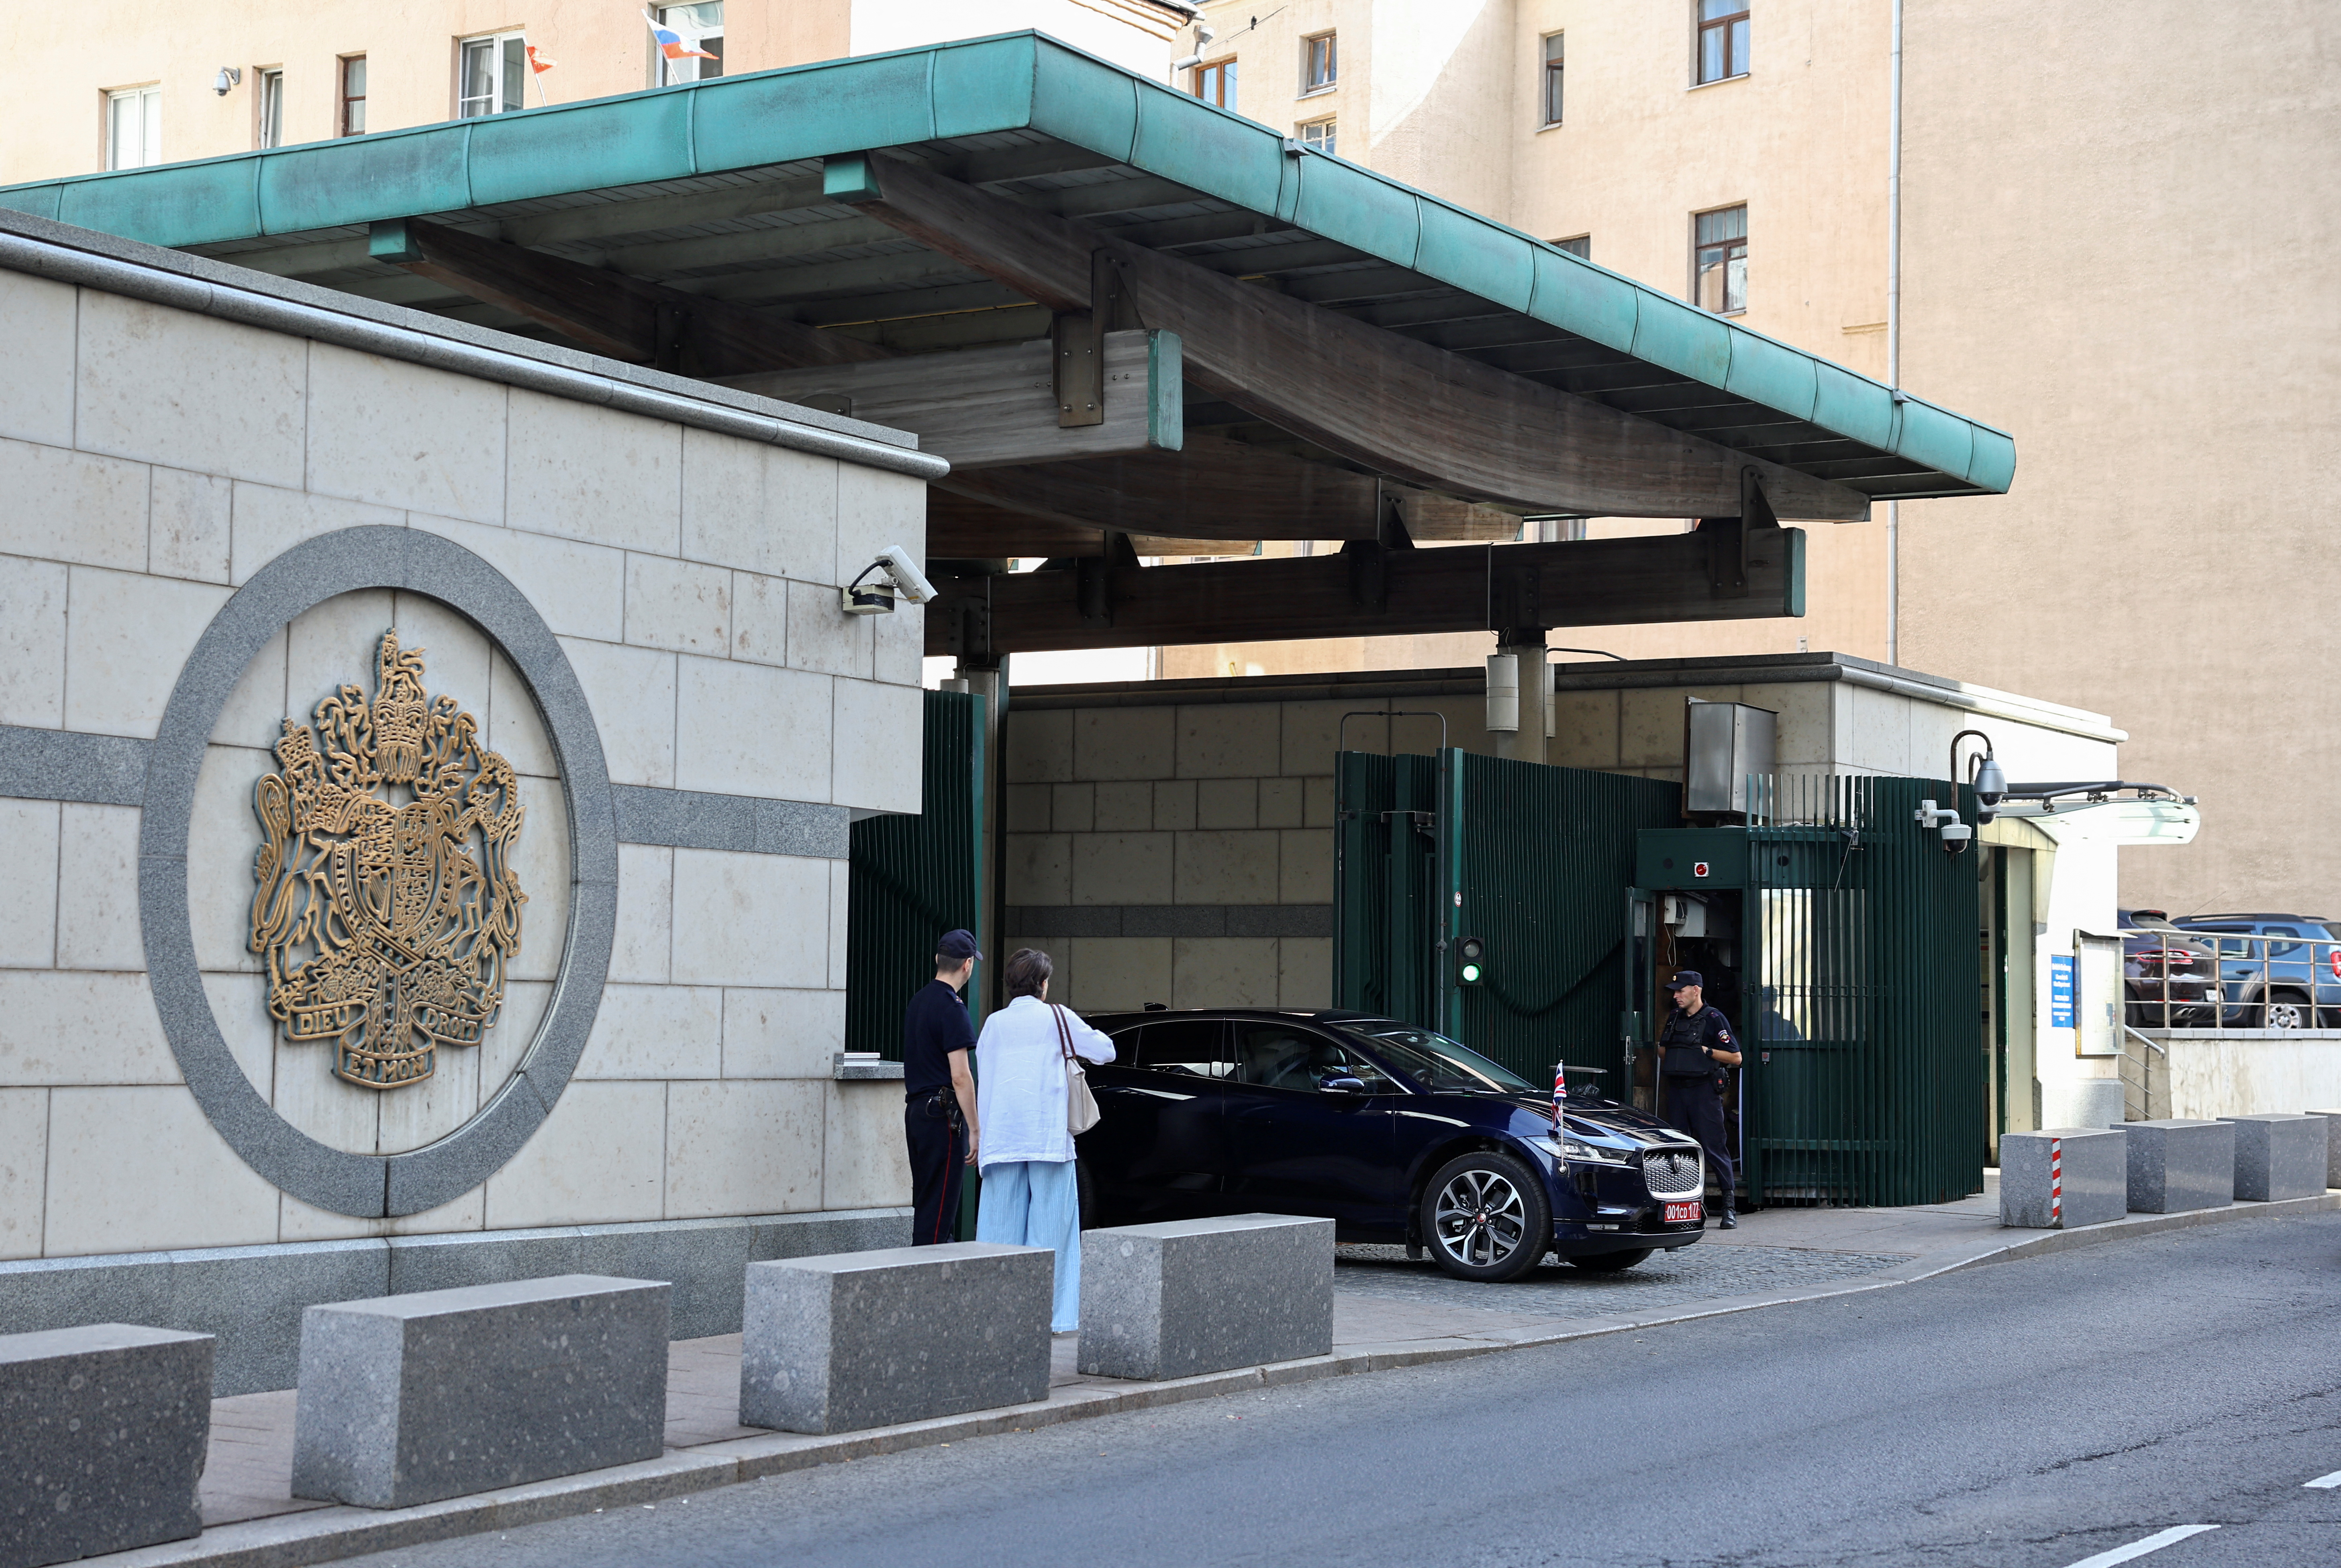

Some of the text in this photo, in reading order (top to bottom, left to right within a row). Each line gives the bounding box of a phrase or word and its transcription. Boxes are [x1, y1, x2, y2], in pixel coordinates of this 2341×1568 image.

[337, 869, 362, 931] HONI
[300, 1005, 350, 1035] DIEU
[425, 1008, 478, 1040] DROIT
[349, 1053, 426, 1083] ET MON
[1667, 1204, 1687, 1219] 001CD
[1693, 1202, 1699, 1213] 77
